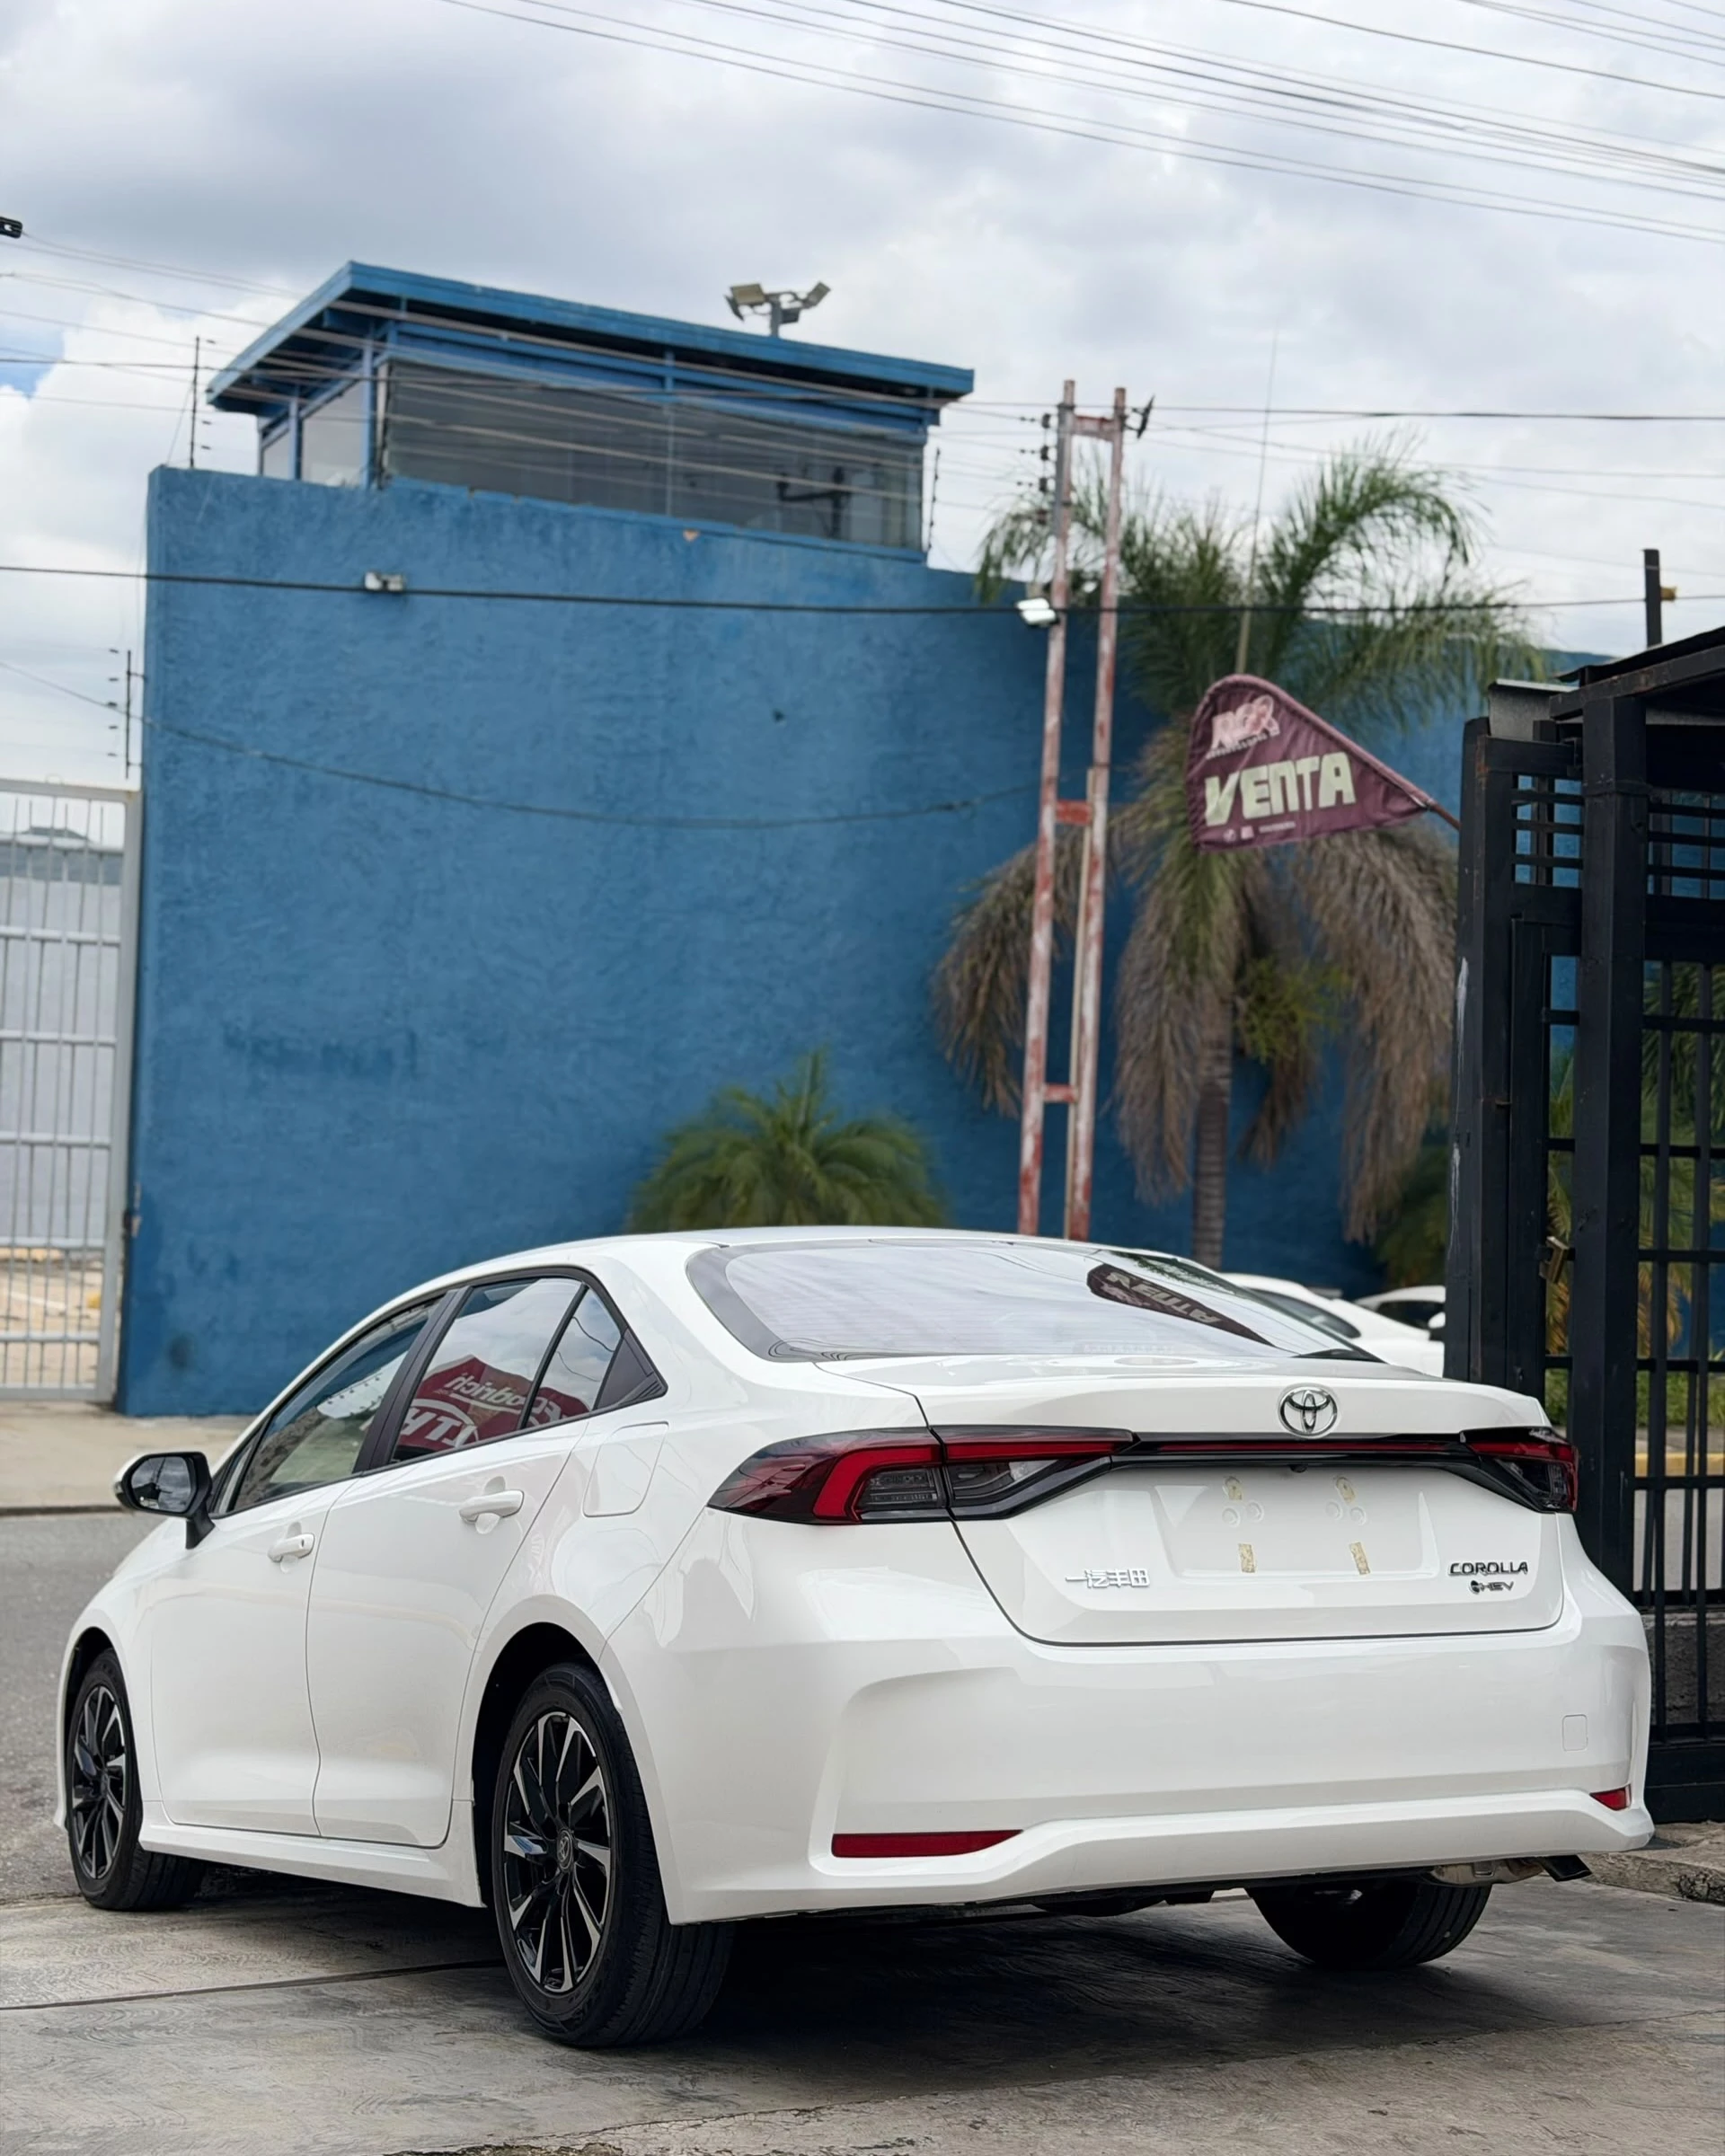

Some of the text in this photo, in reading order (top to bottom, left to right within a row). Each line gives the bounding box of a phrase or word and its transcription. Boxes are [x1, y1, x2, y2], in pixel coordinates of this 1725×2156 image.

[1204, 752, 1356, 826] VENTA
[1448, 1561, 1528, 1576] COROLLA
[1065, 1568, 1150, 1588] 一汽丰田
[1478, 1581, 1514, 1592] HEV
